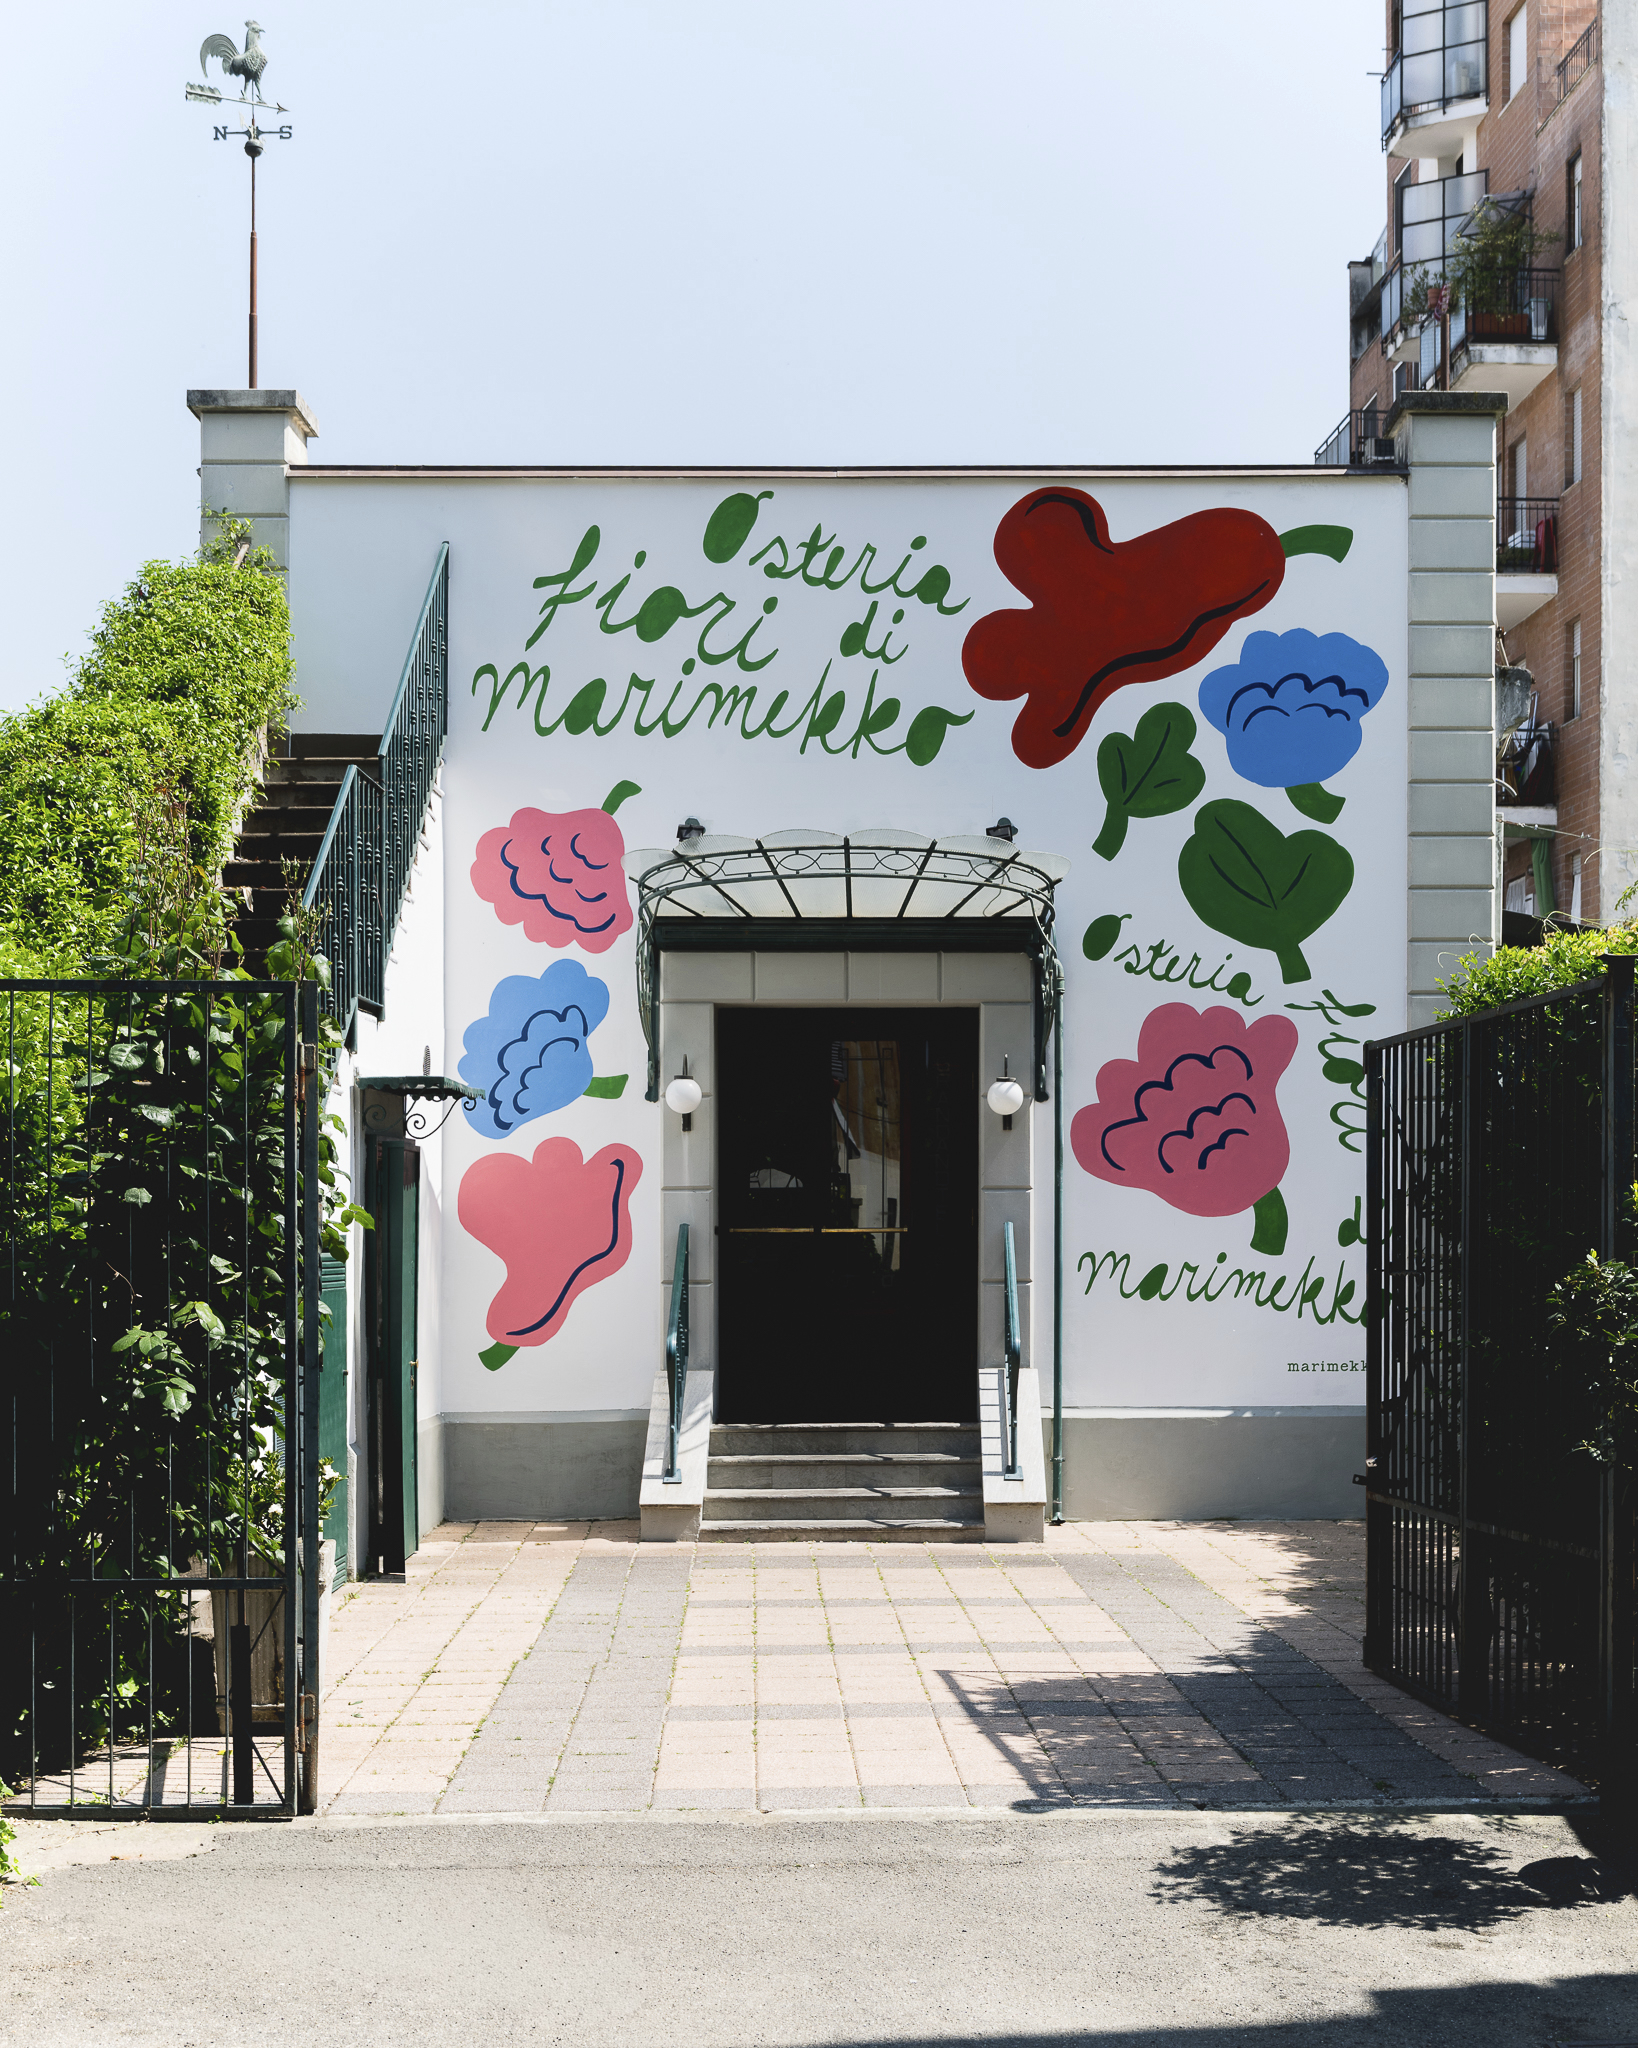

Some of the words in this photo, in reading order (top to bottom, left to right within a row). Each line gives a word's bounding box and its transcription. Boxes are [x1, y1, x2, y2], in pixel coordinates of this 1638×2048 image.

[213, 126, 228, 140] N
[279, 125, 292, 139] S
[703, 491, 971, 615] Osteria
[525, 525, 779, 672] fiori
[840, 601, 909, 664] di
[1082, 914, 1265, 1007] Osteria
[1287, 1360, 1367, 1372] marimekk
